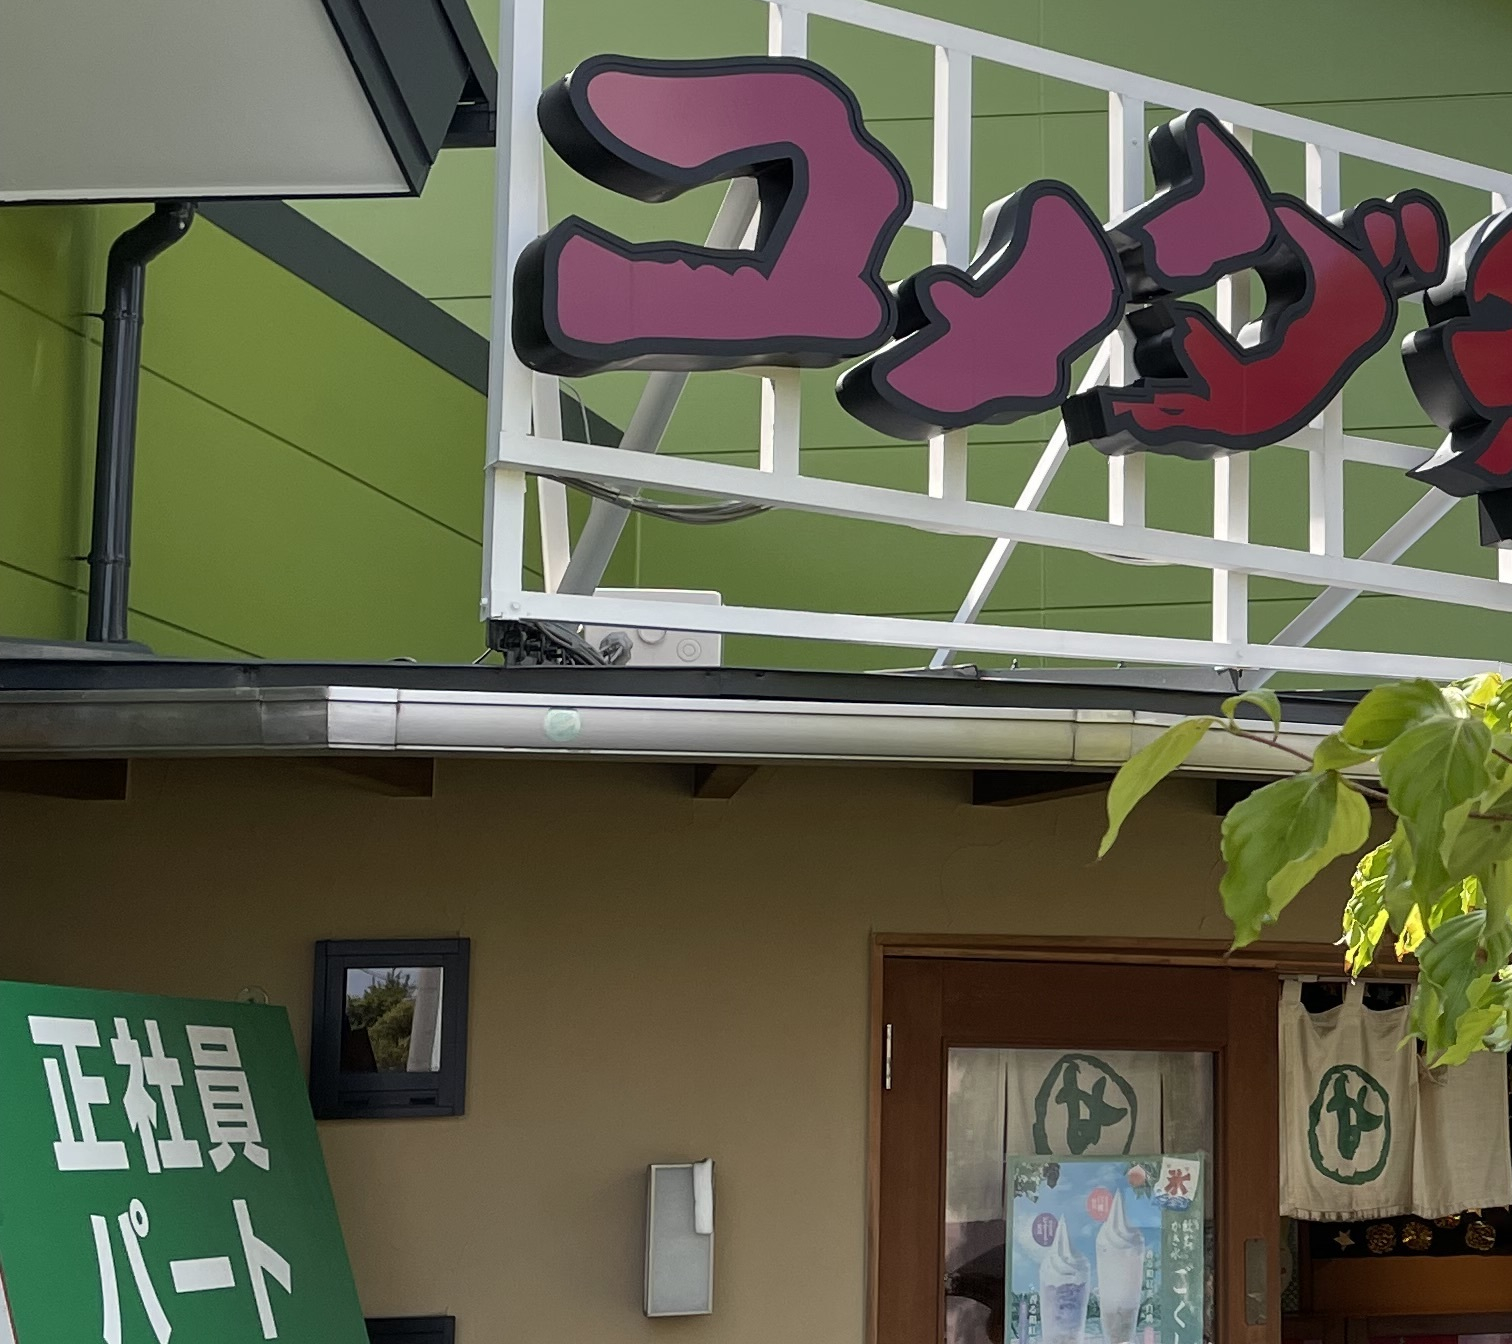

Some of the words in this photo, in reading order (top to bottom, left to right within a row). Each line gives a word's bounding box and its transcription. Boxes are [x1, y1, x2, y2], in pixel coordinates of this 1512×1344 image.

[27, 1013, 271, 1175] 正社員
[1164, 1167, 1192, 1197] 氷
